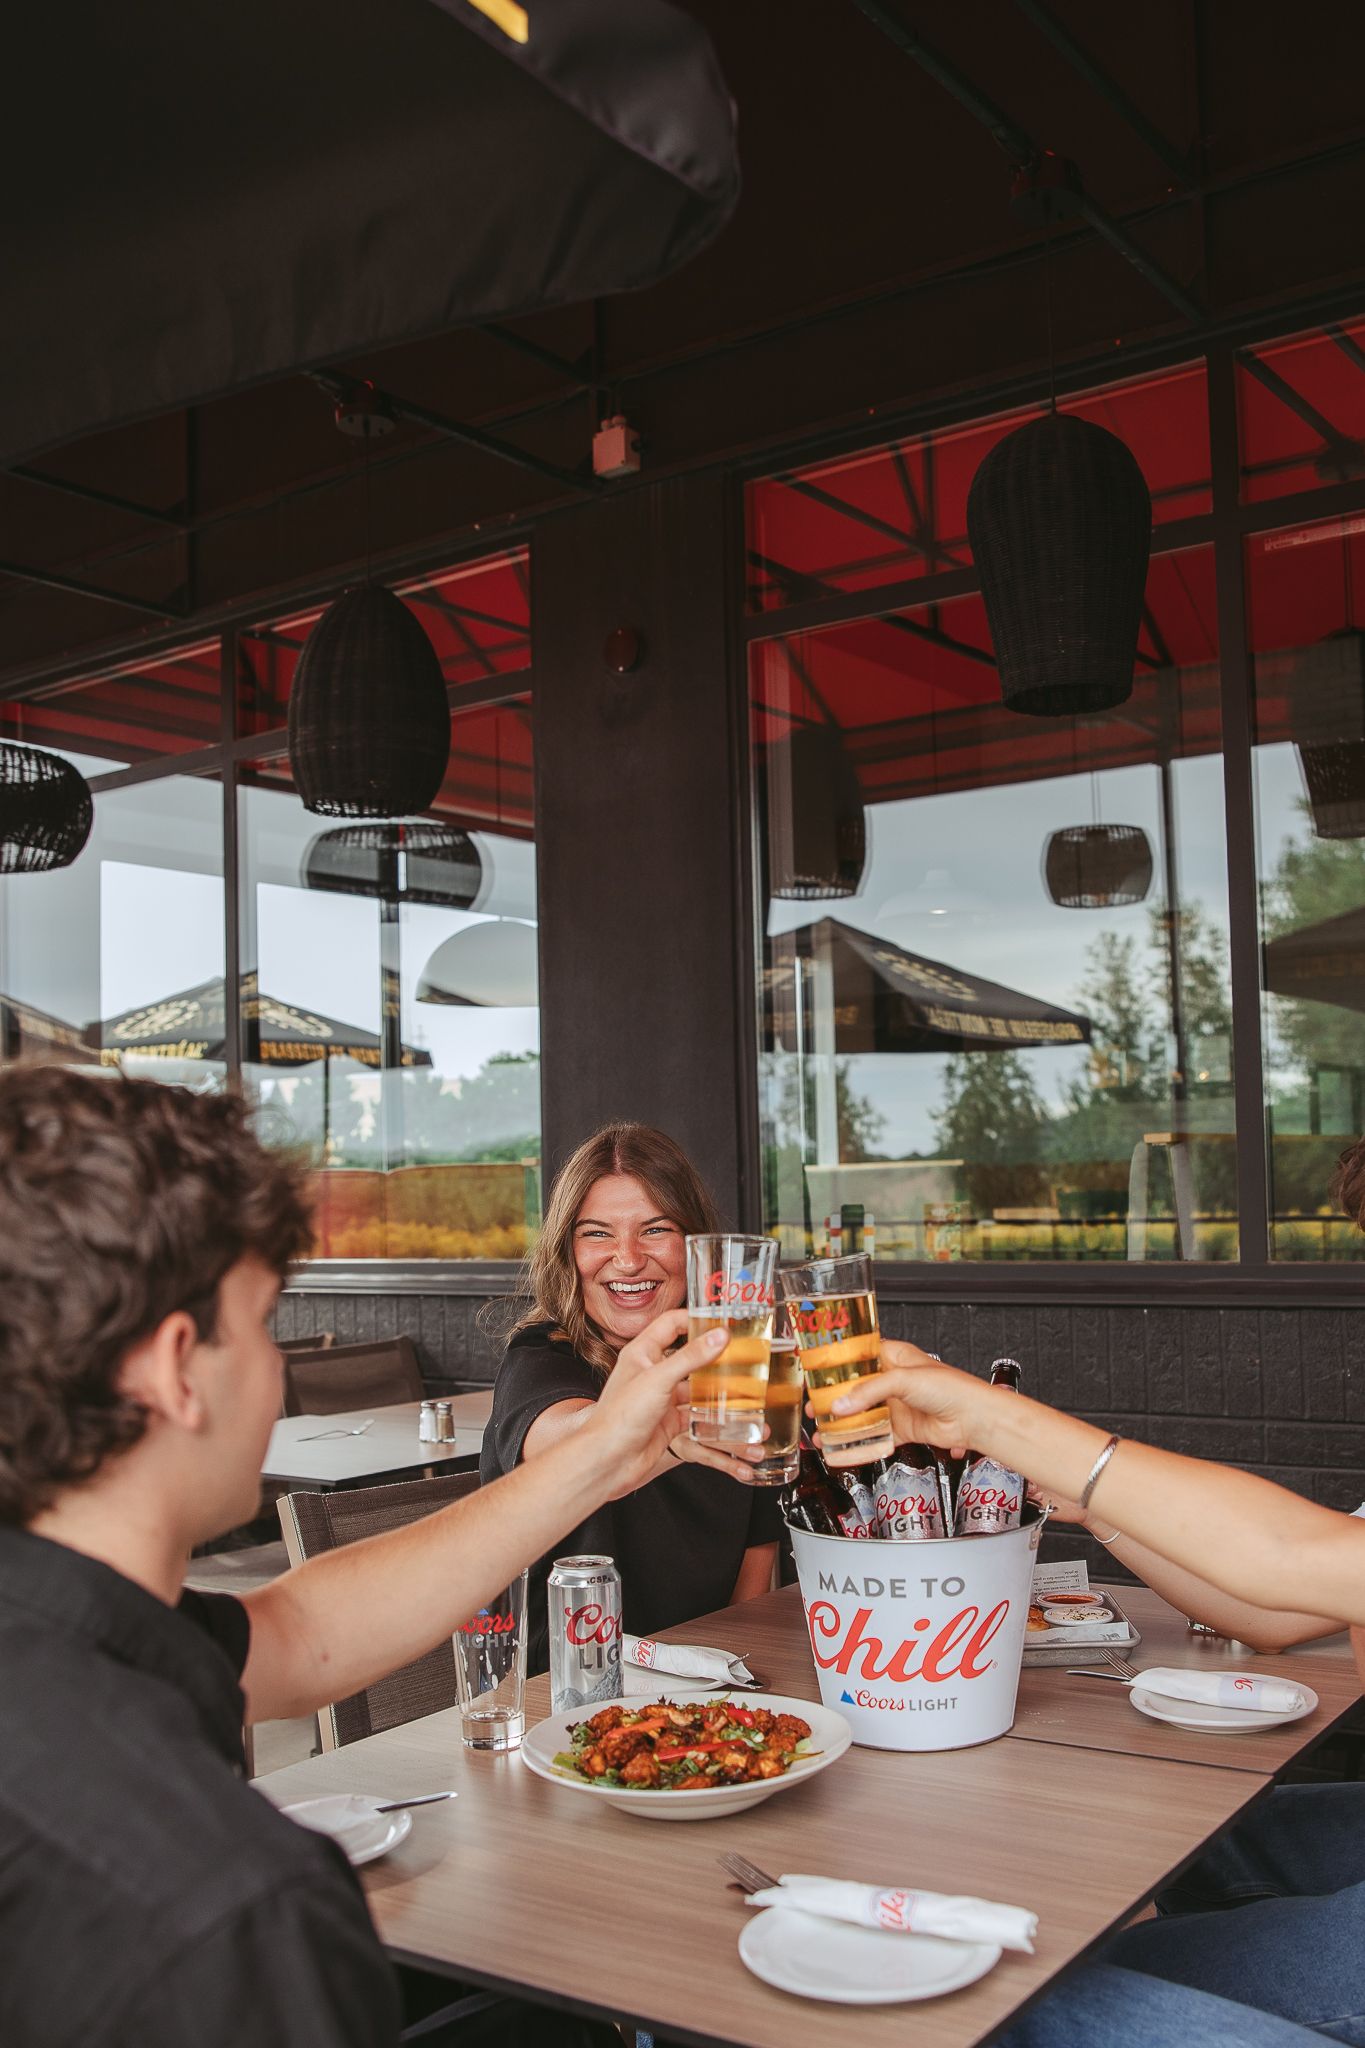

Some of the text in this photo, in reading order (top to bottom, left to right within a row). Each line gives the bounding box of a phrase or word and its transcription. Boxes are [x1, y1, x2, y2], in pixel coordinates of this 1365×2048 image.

[877, 1494, 939, 1526] Coors
[958, 1482, 1019, 1512] Coors
[819, 1571, 966, 1598] MADE TO
[804, 1599, 1010, 1683] Chill
[855, 1689, 958, 1711] Coors LIGHT
